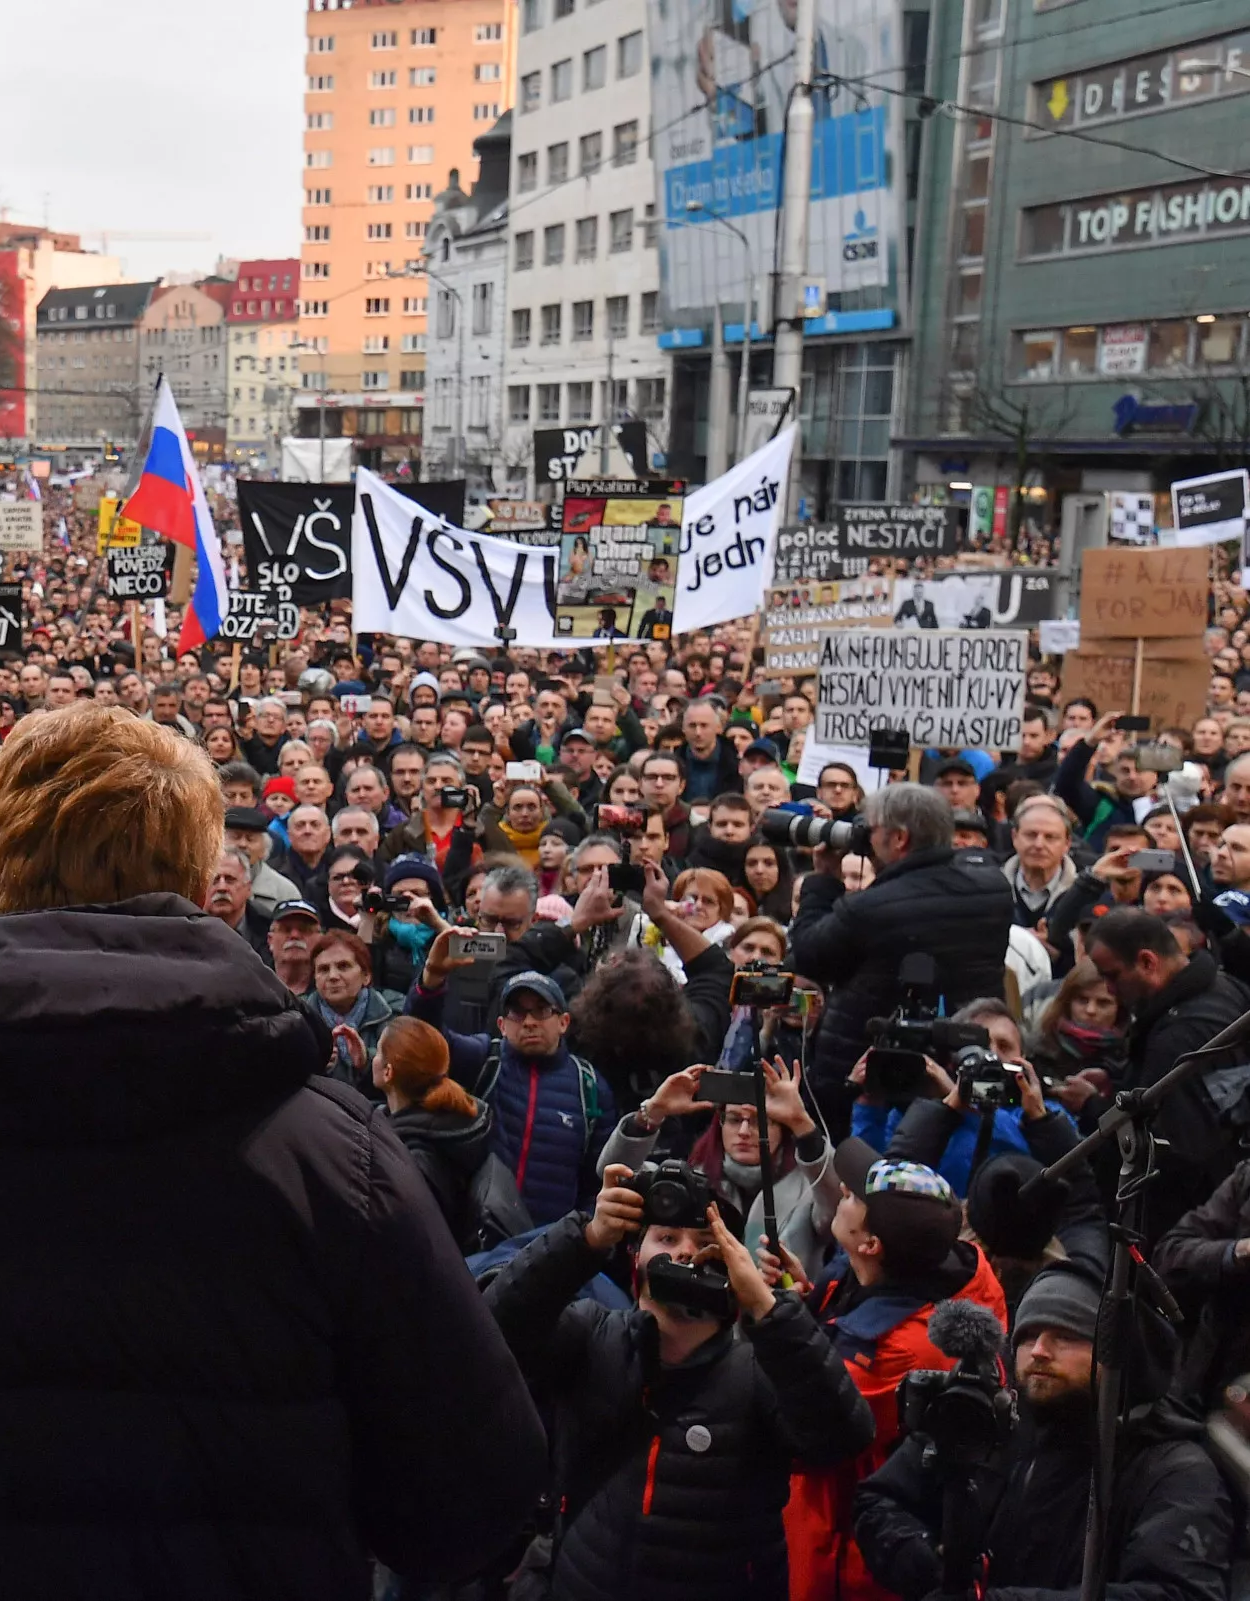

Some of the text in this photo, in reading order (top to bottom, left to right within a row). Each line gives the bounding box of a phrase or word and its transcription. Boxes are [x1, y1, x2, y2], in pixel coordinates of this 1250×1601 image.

[1078, 203, 1130, 243] TOP
[779, 523, 840, 551] poloč
[847, 518, 946, 549] NESTAČÍ
[687, 531, 766, 591] jedn
[1095, 597, 1147, 619] FOR
[821, 636, 1025, 673] AK NEFUNGUJE BORDEL
[819, 669, 886, 706] NESTAČÍ
[888, 671, 966, 709] VYMENIŤ
[939, 711, 1023, 748] NÁSTUP
